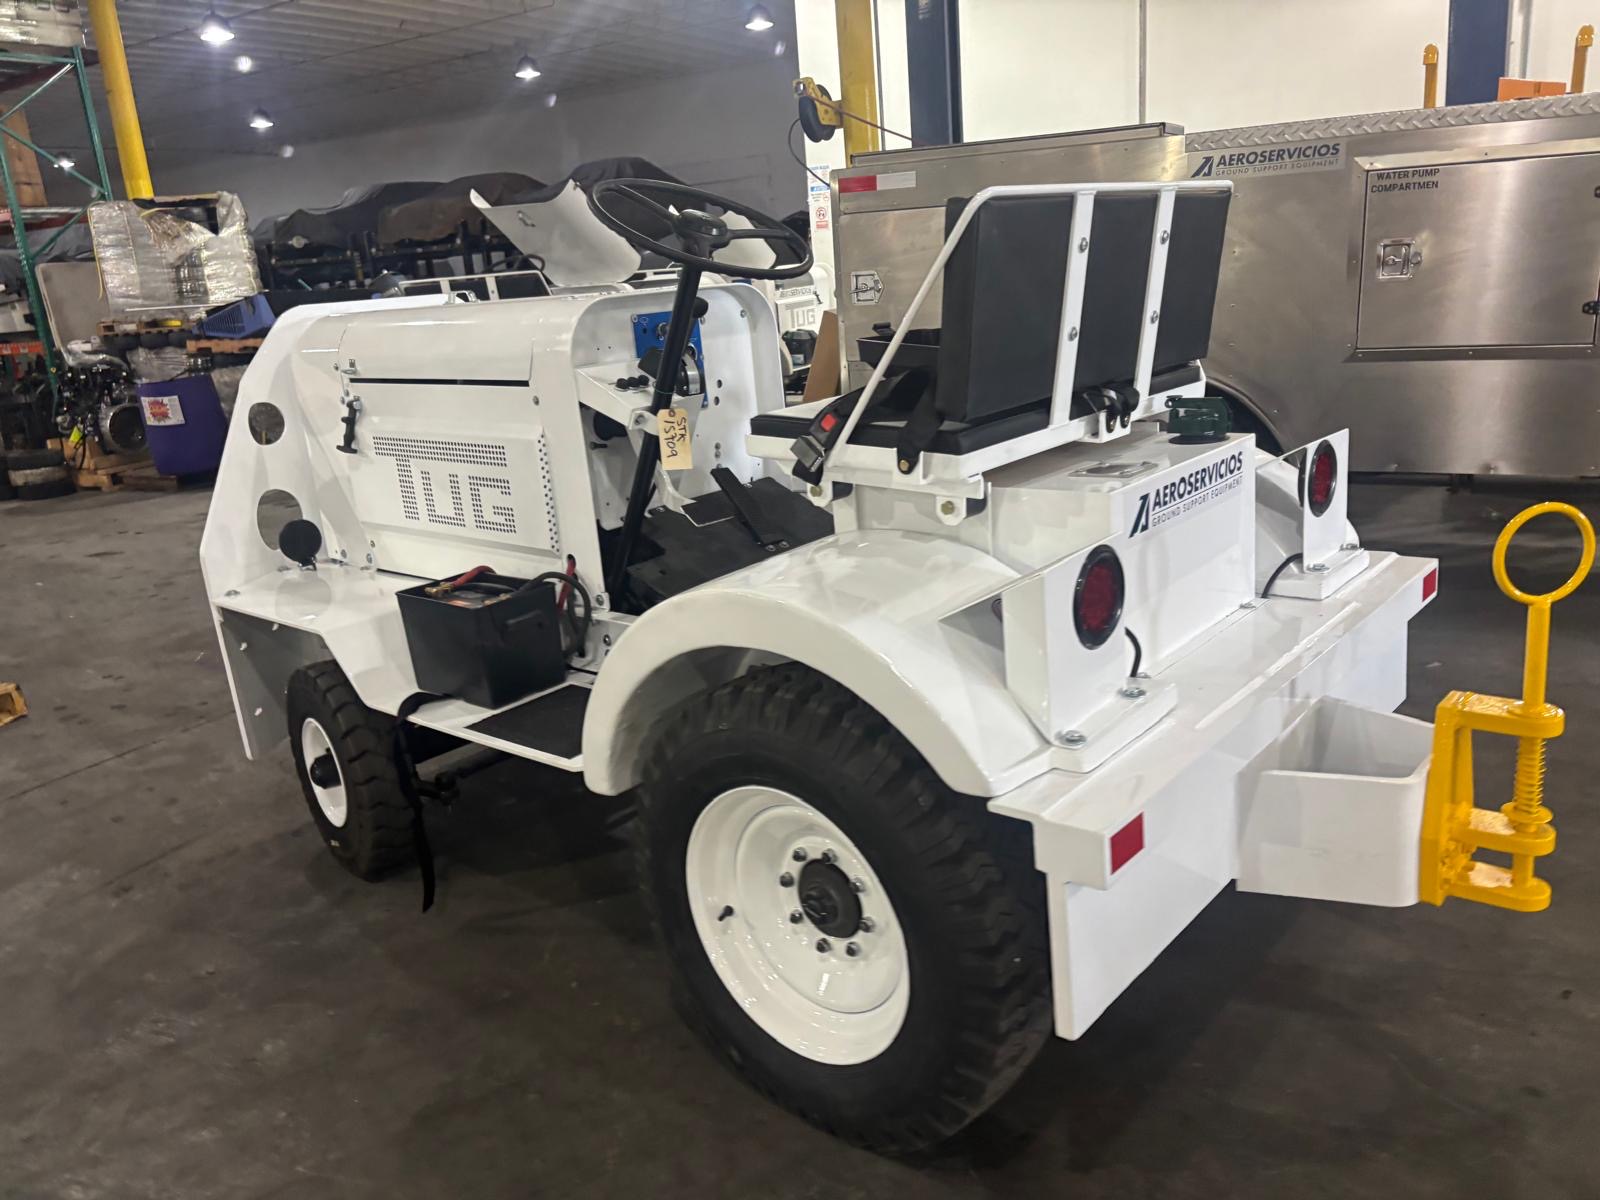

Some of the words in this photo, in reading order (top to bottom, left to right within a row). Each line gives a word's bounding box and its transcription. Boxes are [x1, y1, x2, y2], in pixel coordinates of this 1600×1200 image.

[1215, 168, 1249, 177] GROUND
[1252, 164, 1288, 174] SUPPORT
[1291, 158, 1339, 170] EQUIPMENT
[1216, 143, 1341, 167] AEROSERVICIOS
[1370, 180, 1439, 193] COMPARTMEN
[1376, 170, 1410, 181] WATER
[1412, 167, 1440, 178] PUMP
[676, 416, 687, 442] STK
[372, 436, 517, 534] TUG
[1151, 451, 1243, 512] AEROSERVICIOS
[1151, 506, 1181, 528] GROUND
[1182, 493, 1209, 513] SUPPORT
[1210, 475, 1243, 500] EQUIPMENT
